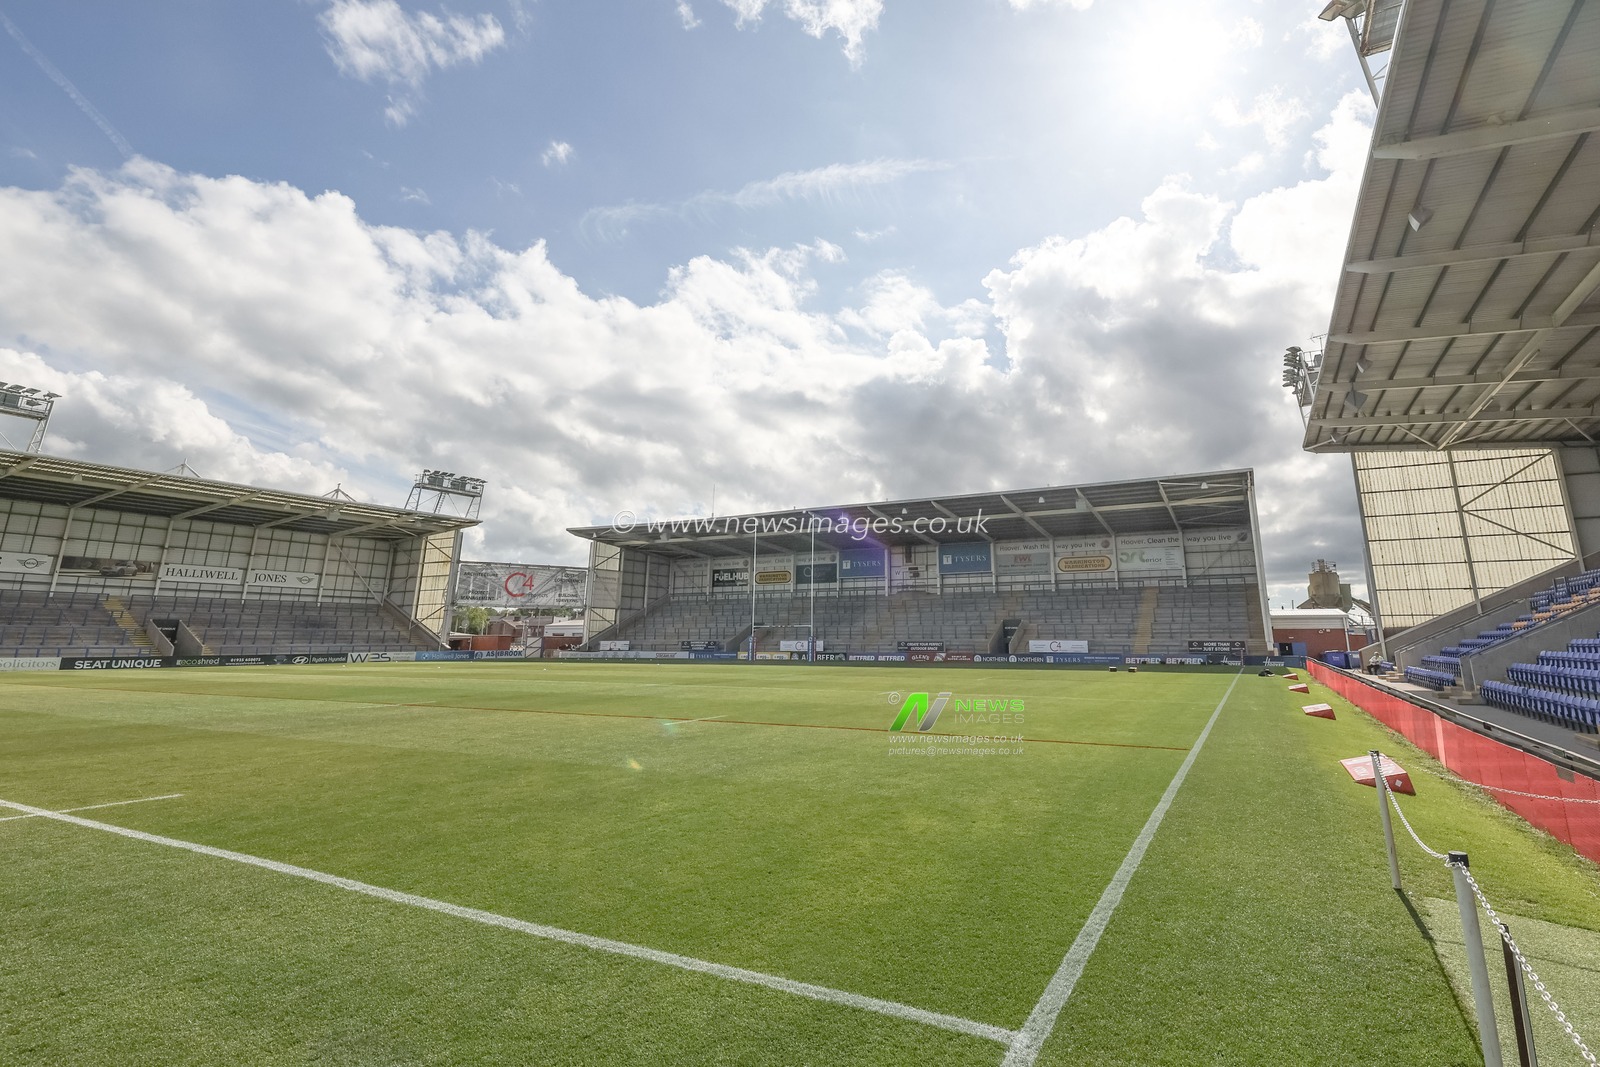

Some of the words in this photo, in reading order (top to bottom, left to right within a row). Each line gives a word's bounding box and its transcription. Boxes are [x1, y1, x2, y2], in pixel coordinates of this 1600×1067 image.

[1203, 535, 1216, 543] you
[1071, 542, 1083, 550] you
[853, 560, 882, 568] TYSERS
[165, 567, 238, 580] HALLIWELL
[253, 573, 287, 583] JONES
[74, 660, 110, 669] SEAT
[111, 659, 162, 669] UNIQUE
